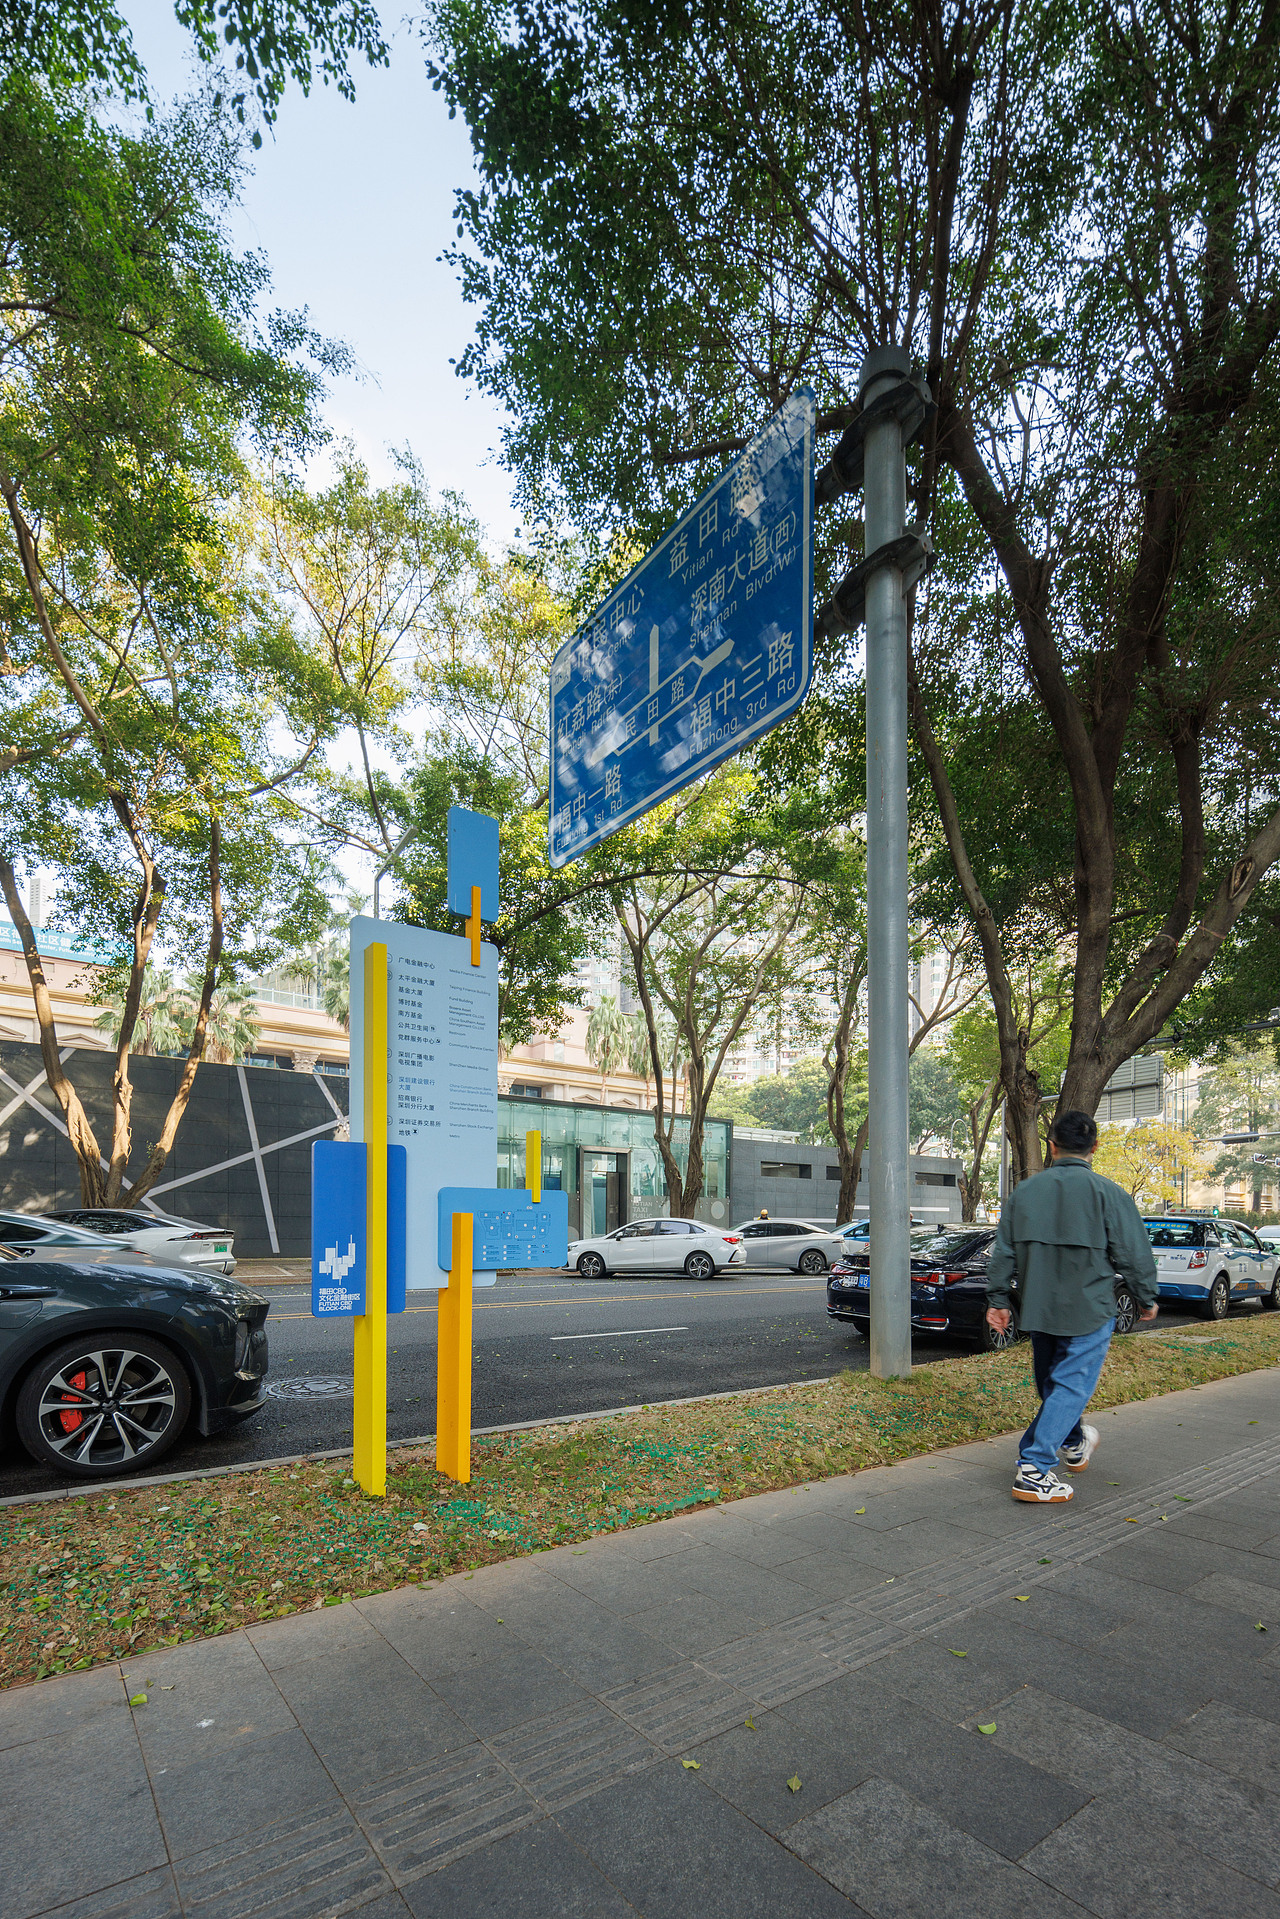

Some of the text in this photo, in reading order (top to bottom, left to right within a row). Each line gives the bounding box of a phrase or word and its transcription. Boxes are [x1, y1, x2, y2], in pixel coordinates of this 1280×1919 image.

[681, 518, 739, 585] Yitian Rd
[691, 511, 797, 627] 深南大道(西)
[690, 545, 796, 648] Shennan Blvd(W)
[625, 676, 685, 742] 民田路
[690, 631, 795, 737] 福中三路
[690, 671, 796, 759] Fuzhong 3rd Rd
[557, 764, 622, 835] 福中一路
[610, 795, 623, 815] Rd
[398, 956, 436, 969] 广电金融中心
[398, 974, 435, 986] 太平金融大厦
[398, 986, 423, 996] 基金大厦
[397, 1010, 423, 1019] 南方基金
[397, 1021, 429, 1032] 公共卫生间
